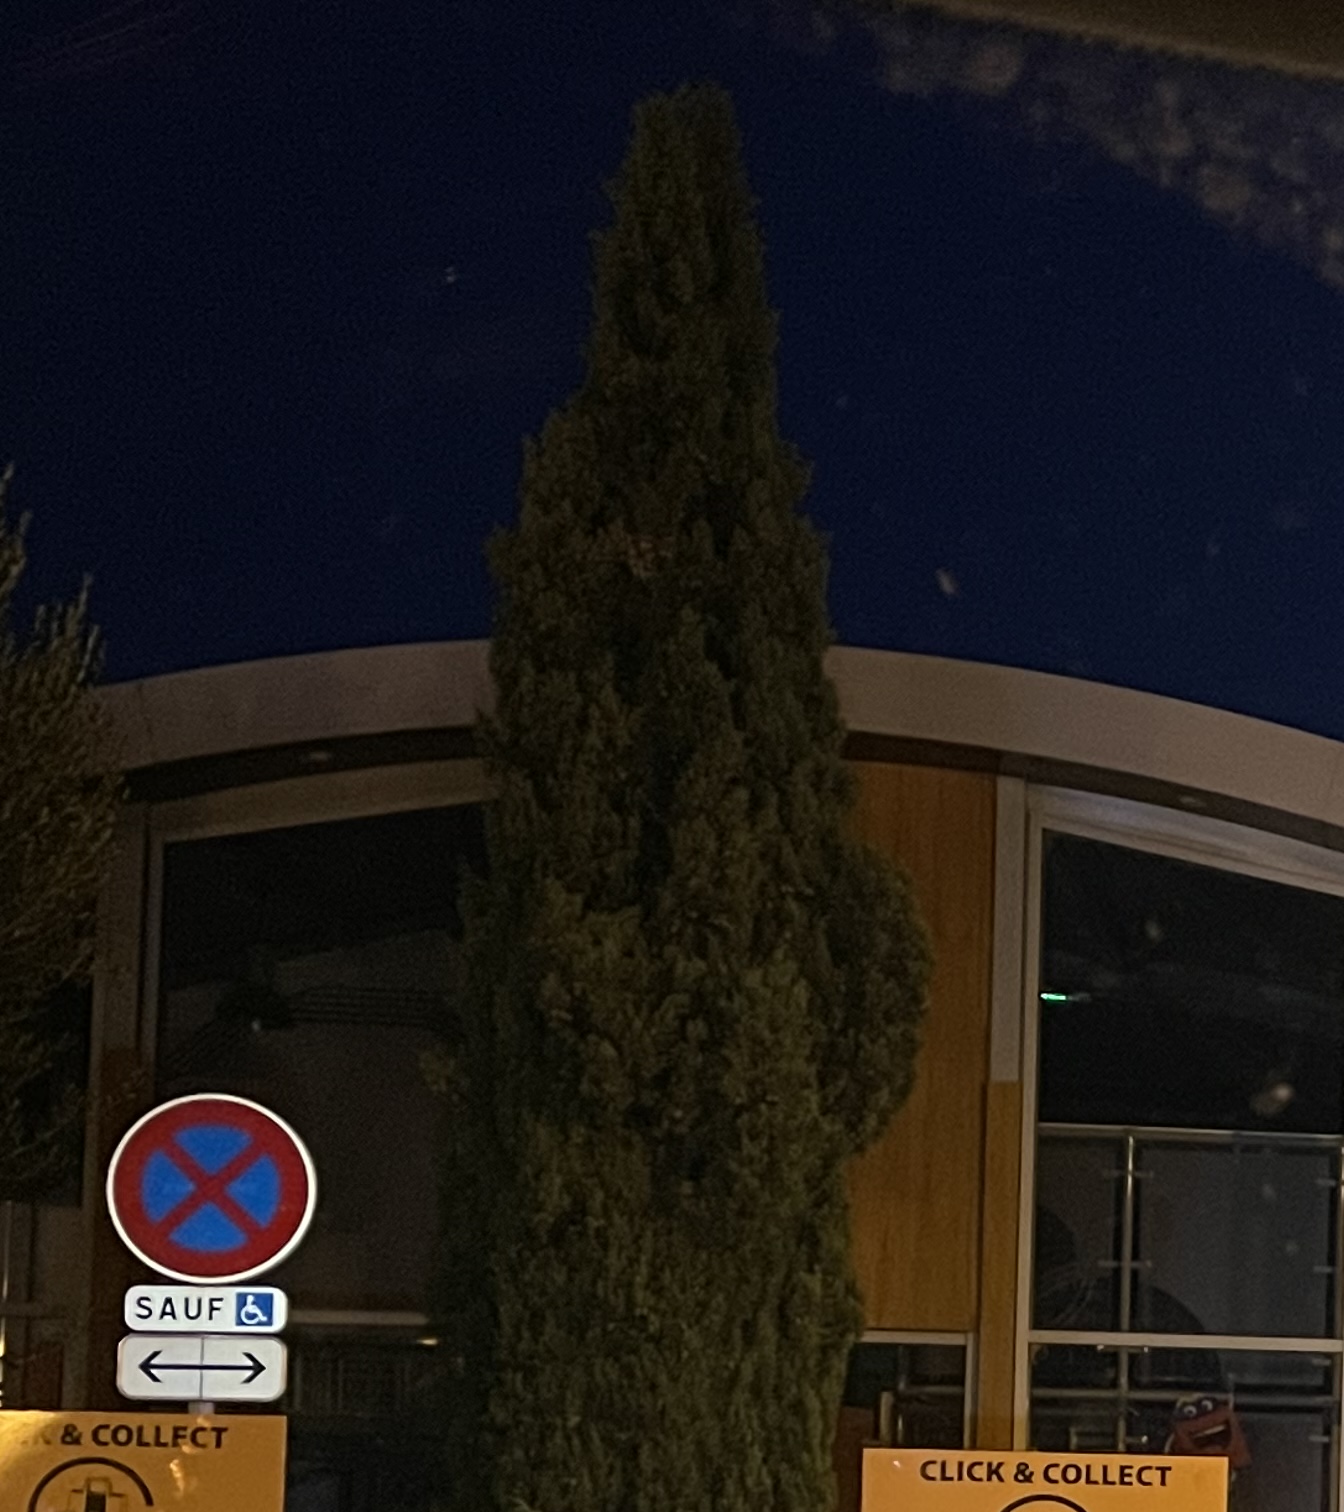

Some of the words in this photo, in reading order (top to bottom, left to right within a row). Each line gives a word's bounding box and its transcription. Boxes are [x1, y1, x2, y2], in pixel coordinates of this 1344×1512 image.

[135, 1296, 224, 1321] SAUF
[60, 1423, 83, 1446] &
[91, 1423, 229, 1449] COLLECT
[919, 1459, 1005, 1483] CLICK
[1013, 1461, 1035, 1484] &
[1043, 1462, 1173, 1487] COLLECT
